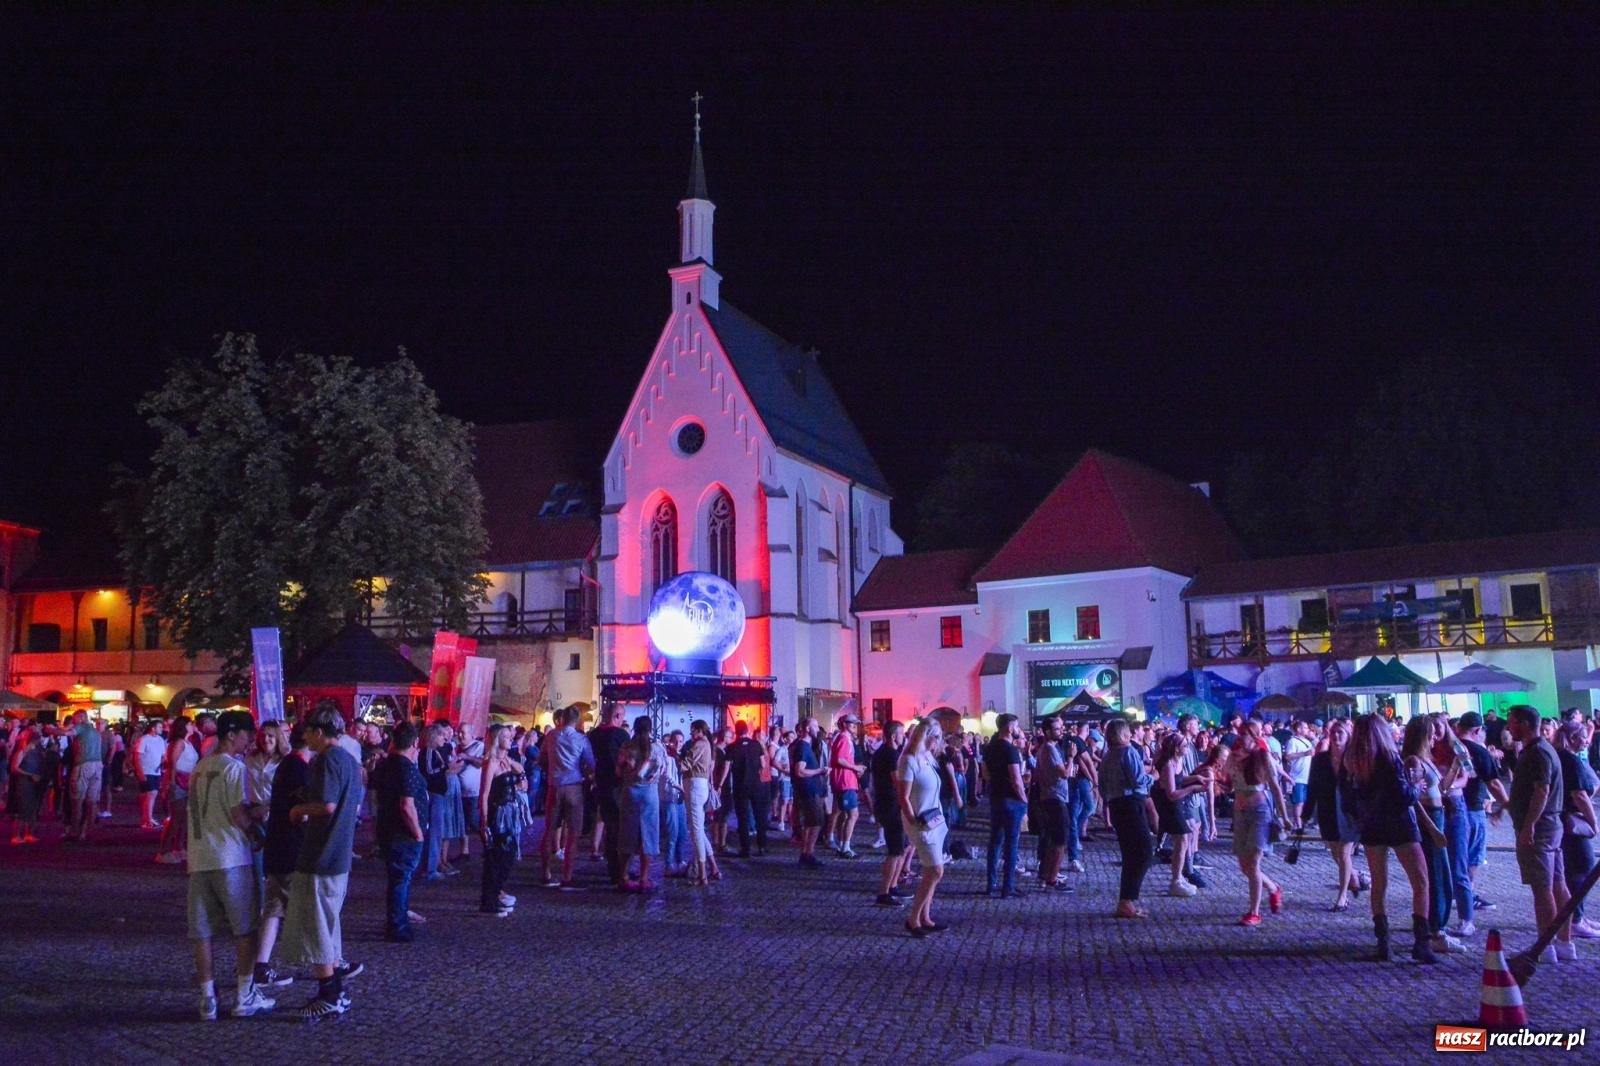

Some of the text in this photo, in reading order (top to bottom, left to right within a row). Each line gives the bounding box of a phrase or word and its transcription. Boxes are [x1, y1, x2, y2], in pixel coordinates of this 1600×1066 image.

[1041, 678, 1089, 687] SEE YOU NEXT YEAR
